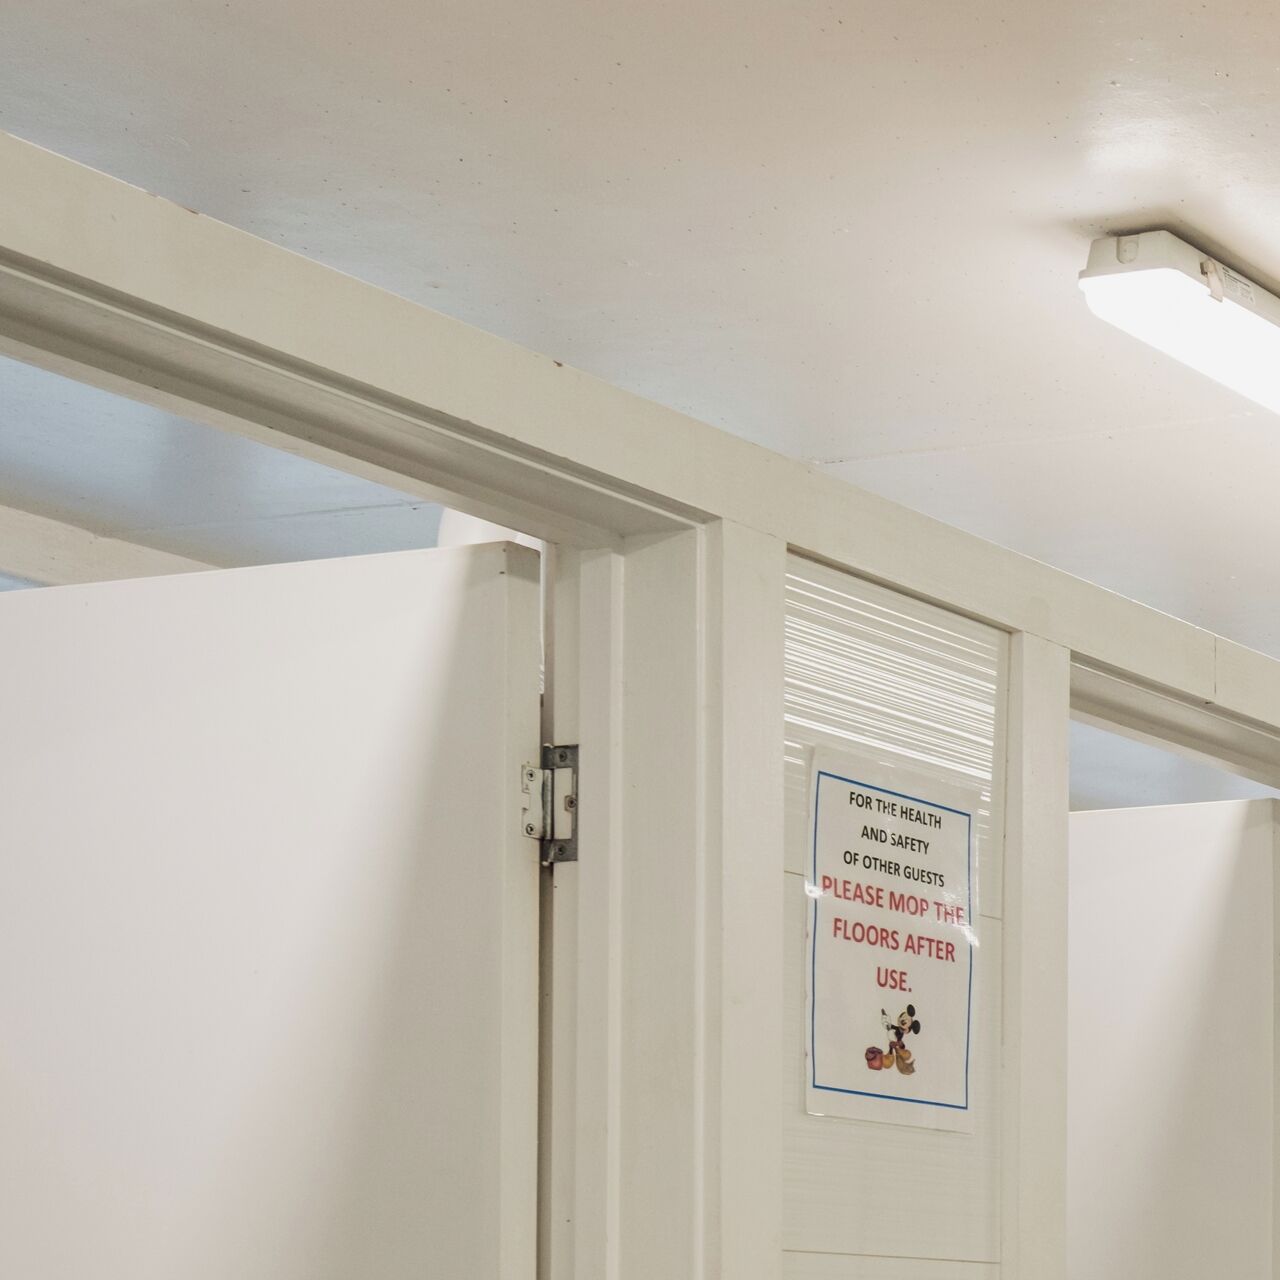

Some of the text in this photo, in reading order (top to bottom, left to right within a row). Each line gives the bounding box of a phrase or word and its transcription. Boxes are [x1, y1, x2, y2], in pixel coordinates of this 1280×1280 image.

[848, 791, 942, 829] FOR THE HEALTH
[861, 825, 930, 855] AND SAFETY
[843, 849, 945, 888] OF OTHER GUESTS
[821, 874, 966, 927] PLEASE MOP THE
[832, 917, 956, 963] FLOORS AFTER
[876, 967, 912, 993] USE.
